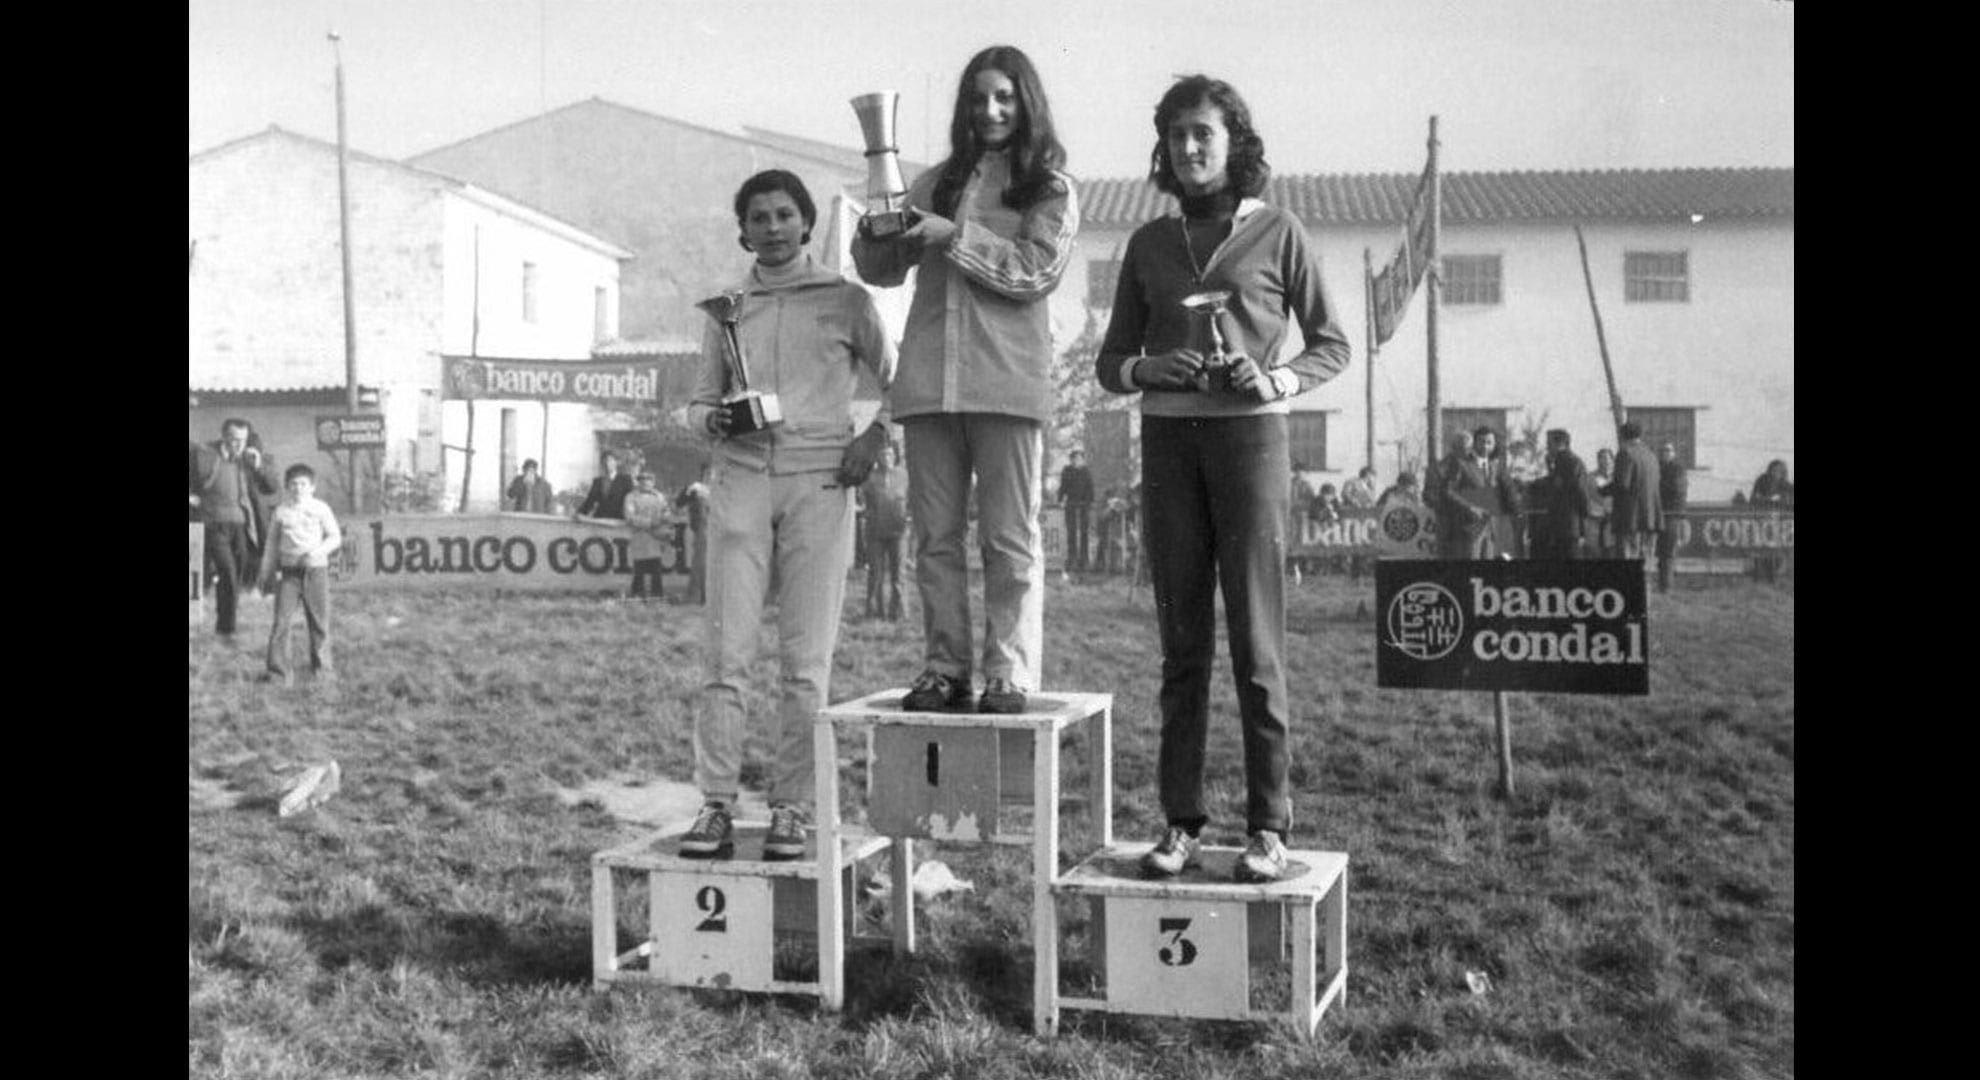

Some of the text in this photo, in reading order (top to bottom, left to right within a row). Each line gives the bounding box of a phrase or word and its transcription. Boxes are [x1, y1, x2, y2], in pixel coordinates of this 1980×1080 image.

[484, 361, 659, 400] banco condal
[369, 521, 537, 575] banco
[1301, 510, 1377, 547] banc
[1703, 512, 1794, 548] conda
[1470, 577, 1625, 619] banco
[1472, 623, 1644, 665] condal
[695, 885, 728, 933] 2
[1159, 917, 1198, 966] 3
